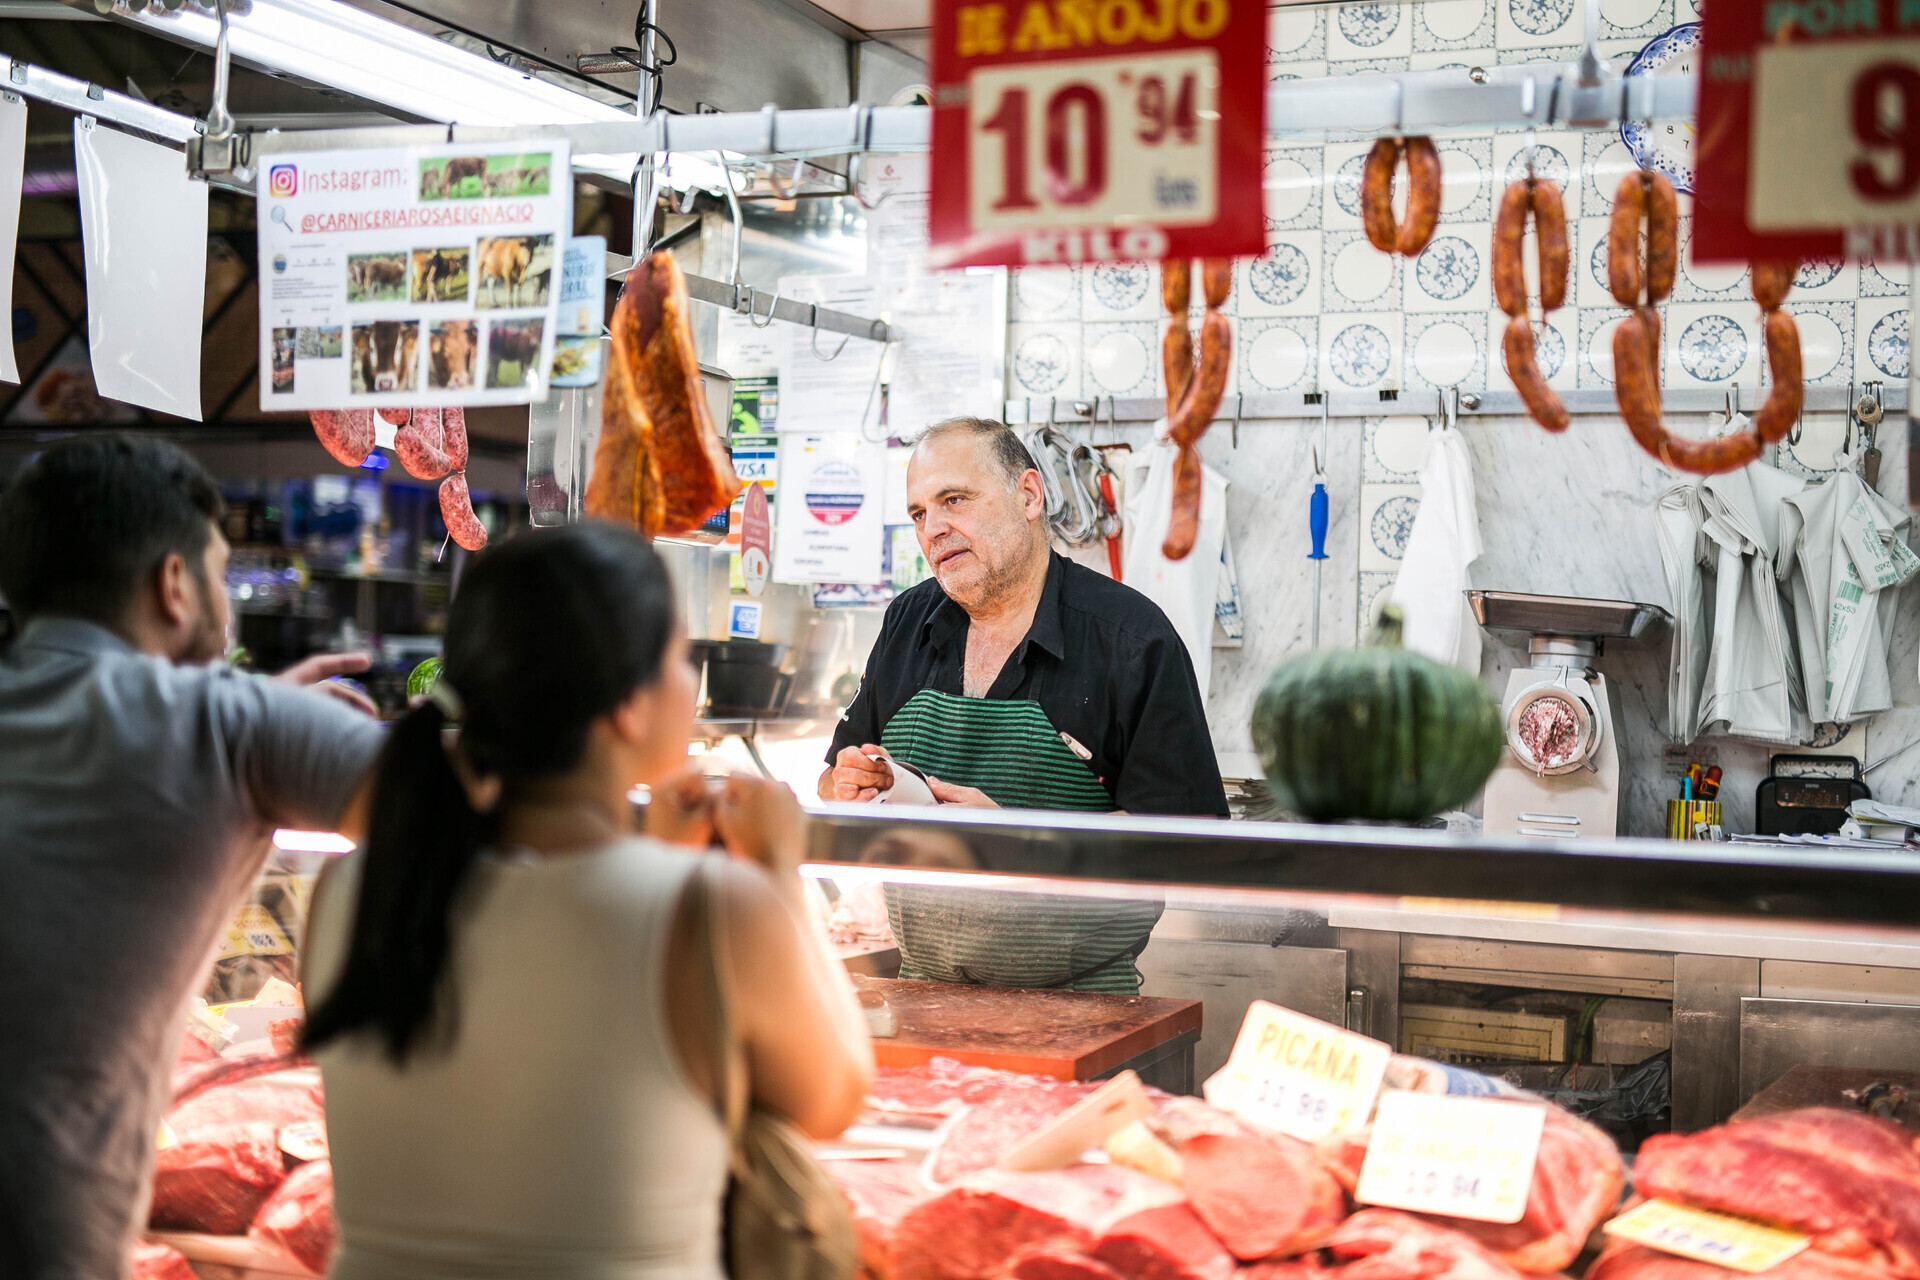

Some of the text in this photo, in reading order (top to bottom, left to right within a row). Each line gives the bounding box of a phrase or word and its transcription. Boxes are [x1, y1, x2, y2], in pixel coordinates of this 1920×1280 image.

[1666, 124, 1675, 135] 8
[302, 166, 408, 194] Instagram:
[301, 203, 534, 233] @CARNICERIAROSAEIGNACIO
[1020, 228, 1170, 263] KILO
[1832, 602, 1857, 615] 42x53
